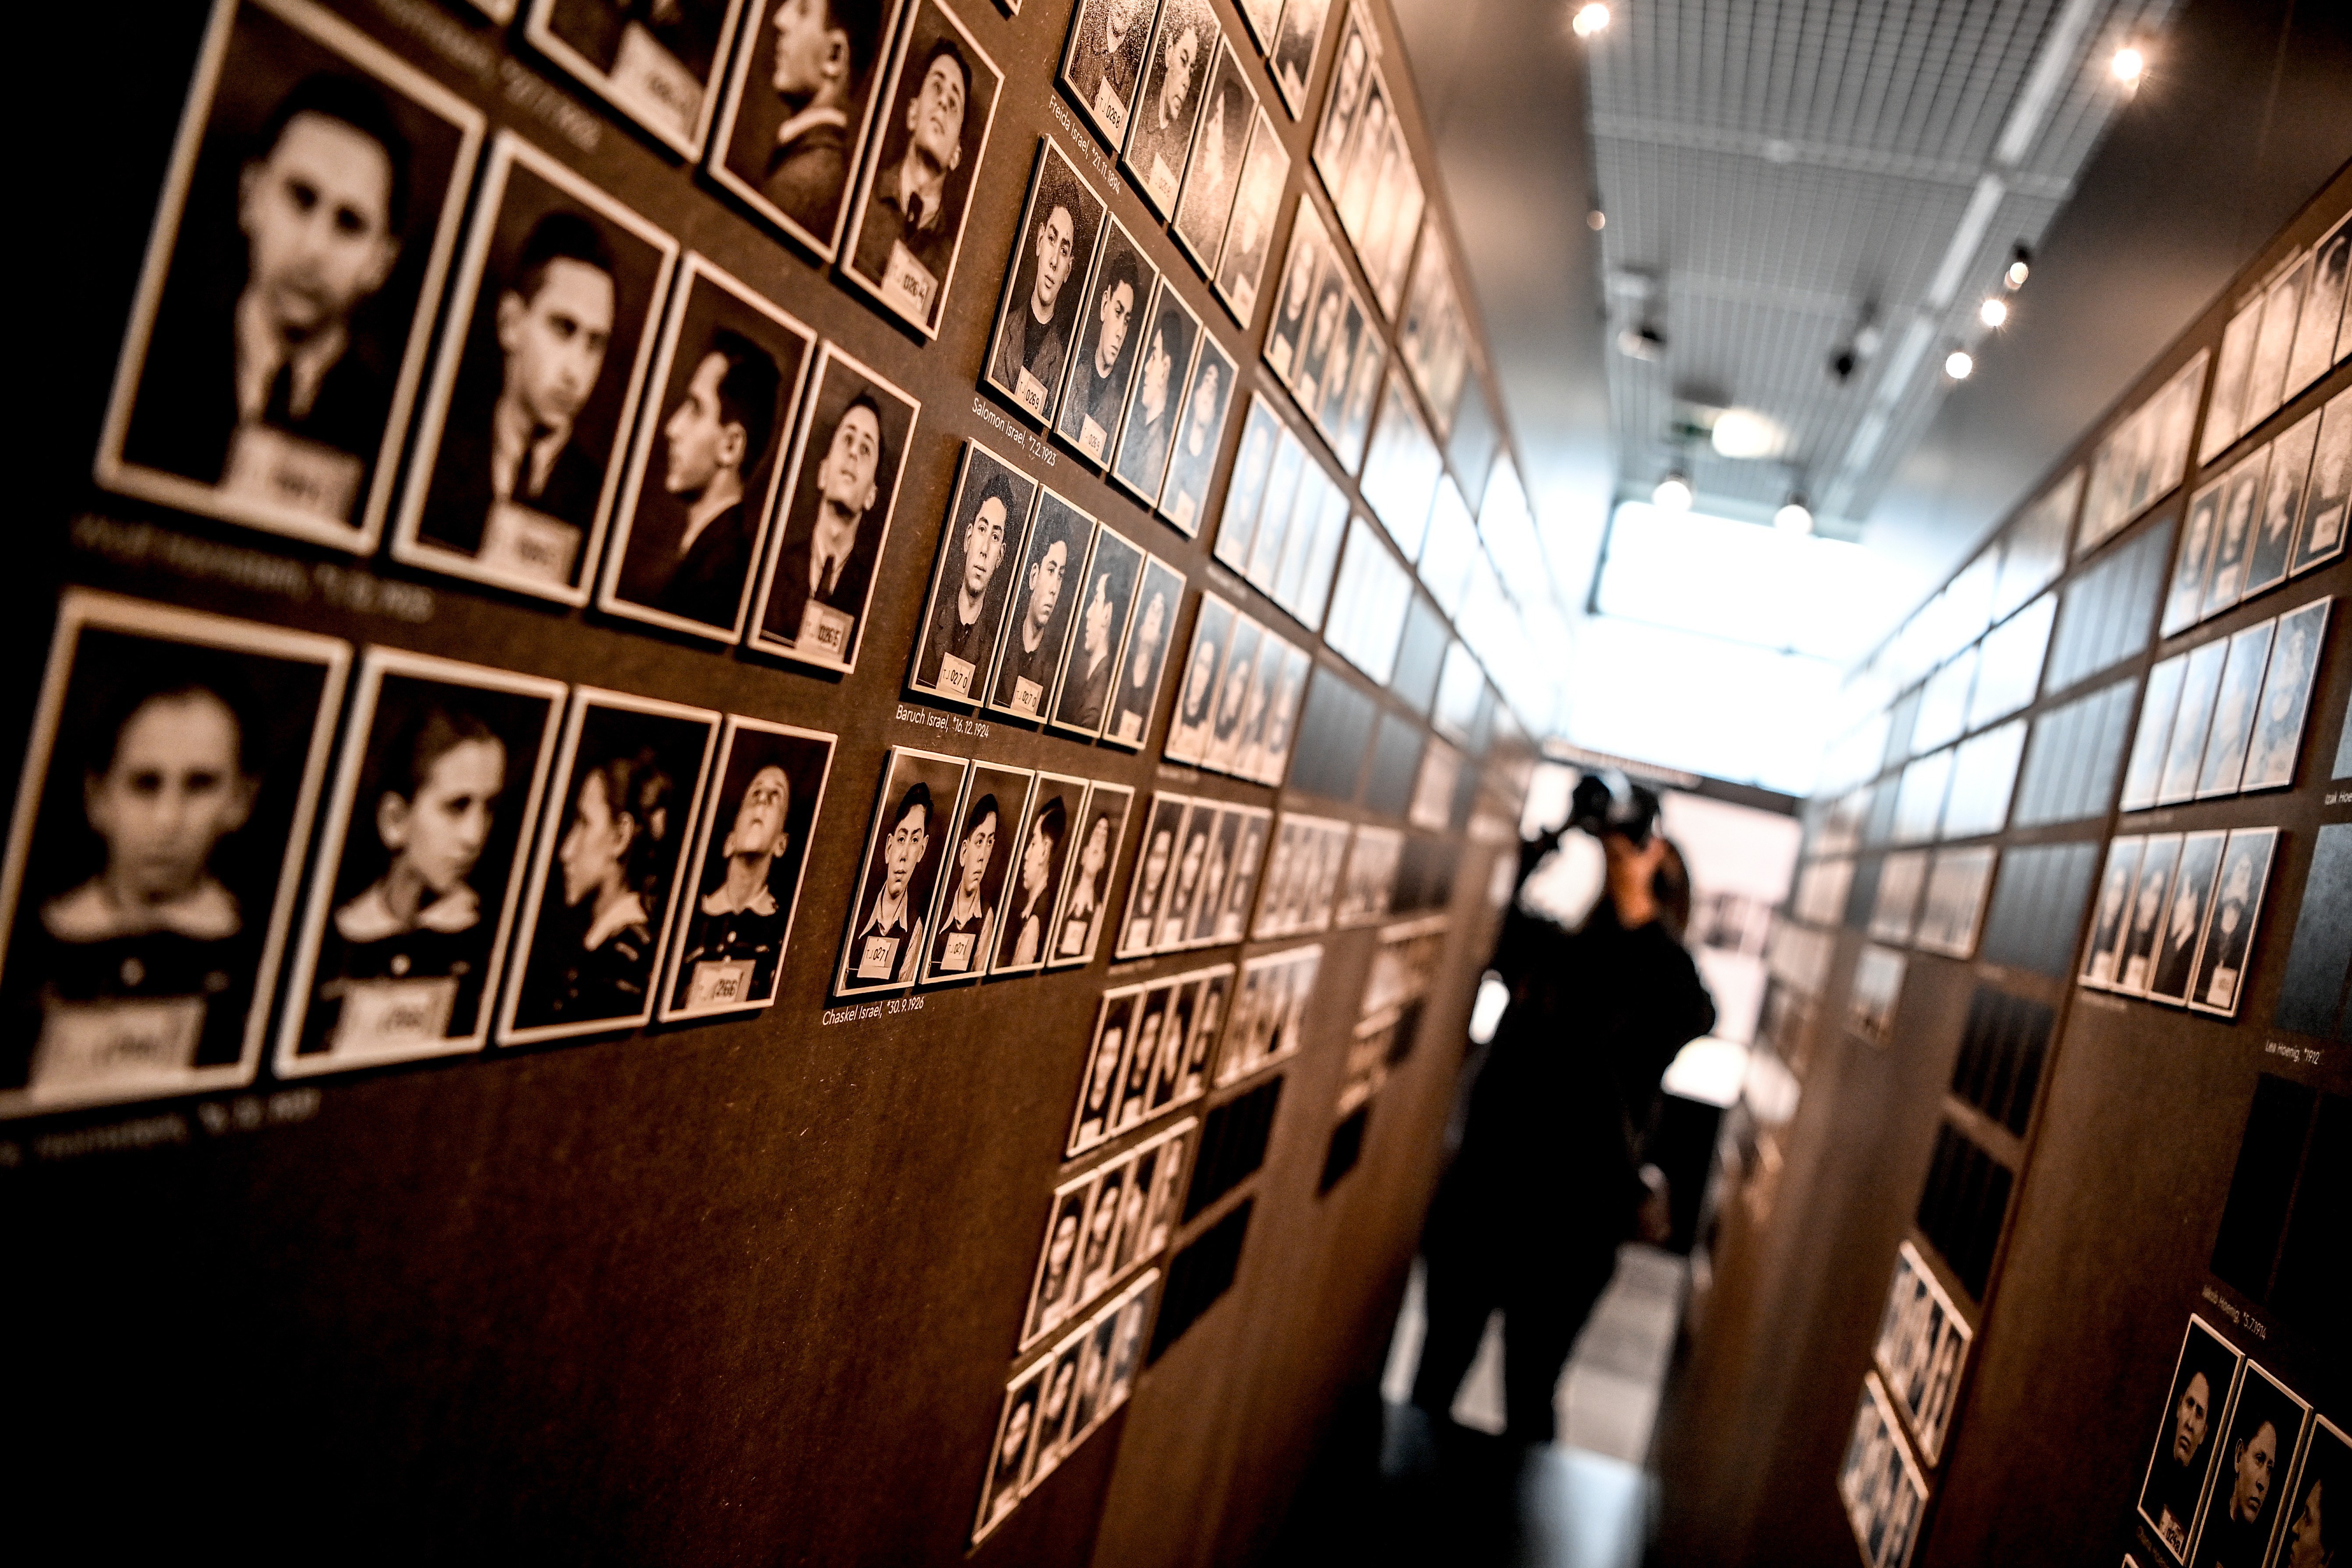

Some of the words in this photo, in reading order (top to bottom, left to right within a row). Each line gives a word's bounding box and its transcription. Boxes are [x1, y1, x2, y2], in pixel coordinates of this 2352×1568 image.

[1049, 95, 1070, 131] Freida
[1071, 123, 1090, 159] Israel,
[1106, 105, 1121, 129] 0268
[1026, 389, 1039, 410] 0269
[972, 397, 1005, 433] Salomon
[1006, 422, 1026, 450] Israel,
[1089, 434, 1100, 452] 0269
[950, 669, 968, 689] 0270
[896, 704, 926, 724] Baruch
[927, 709, 950, 733] Israel,
[873, 946, 889, 961] 0271
[822, 1004, 858, 1026] Chaskel
[858, 1000, 883, 1020] Israel,
